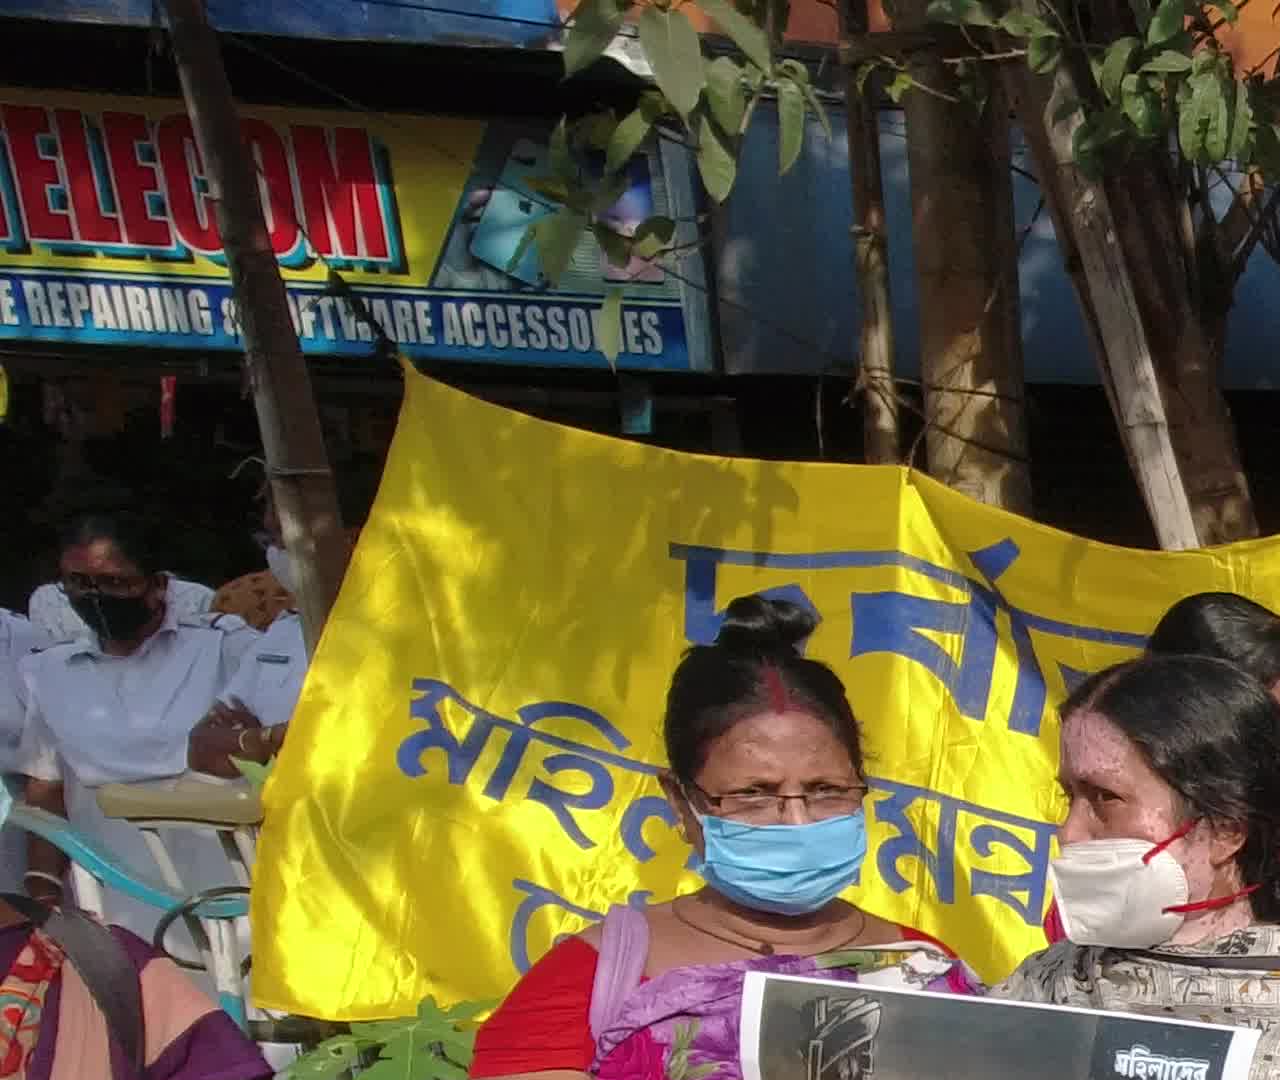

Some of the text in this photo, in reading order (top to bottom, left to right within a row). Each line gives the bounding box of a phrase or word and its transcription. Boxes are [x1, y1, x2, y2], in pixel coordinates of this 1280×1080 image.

[0, 104, 394, 262] ELECOM
[21, 280, 214, 336] REPAIRING
[442, 301, 664, 355] ACCESSOES
